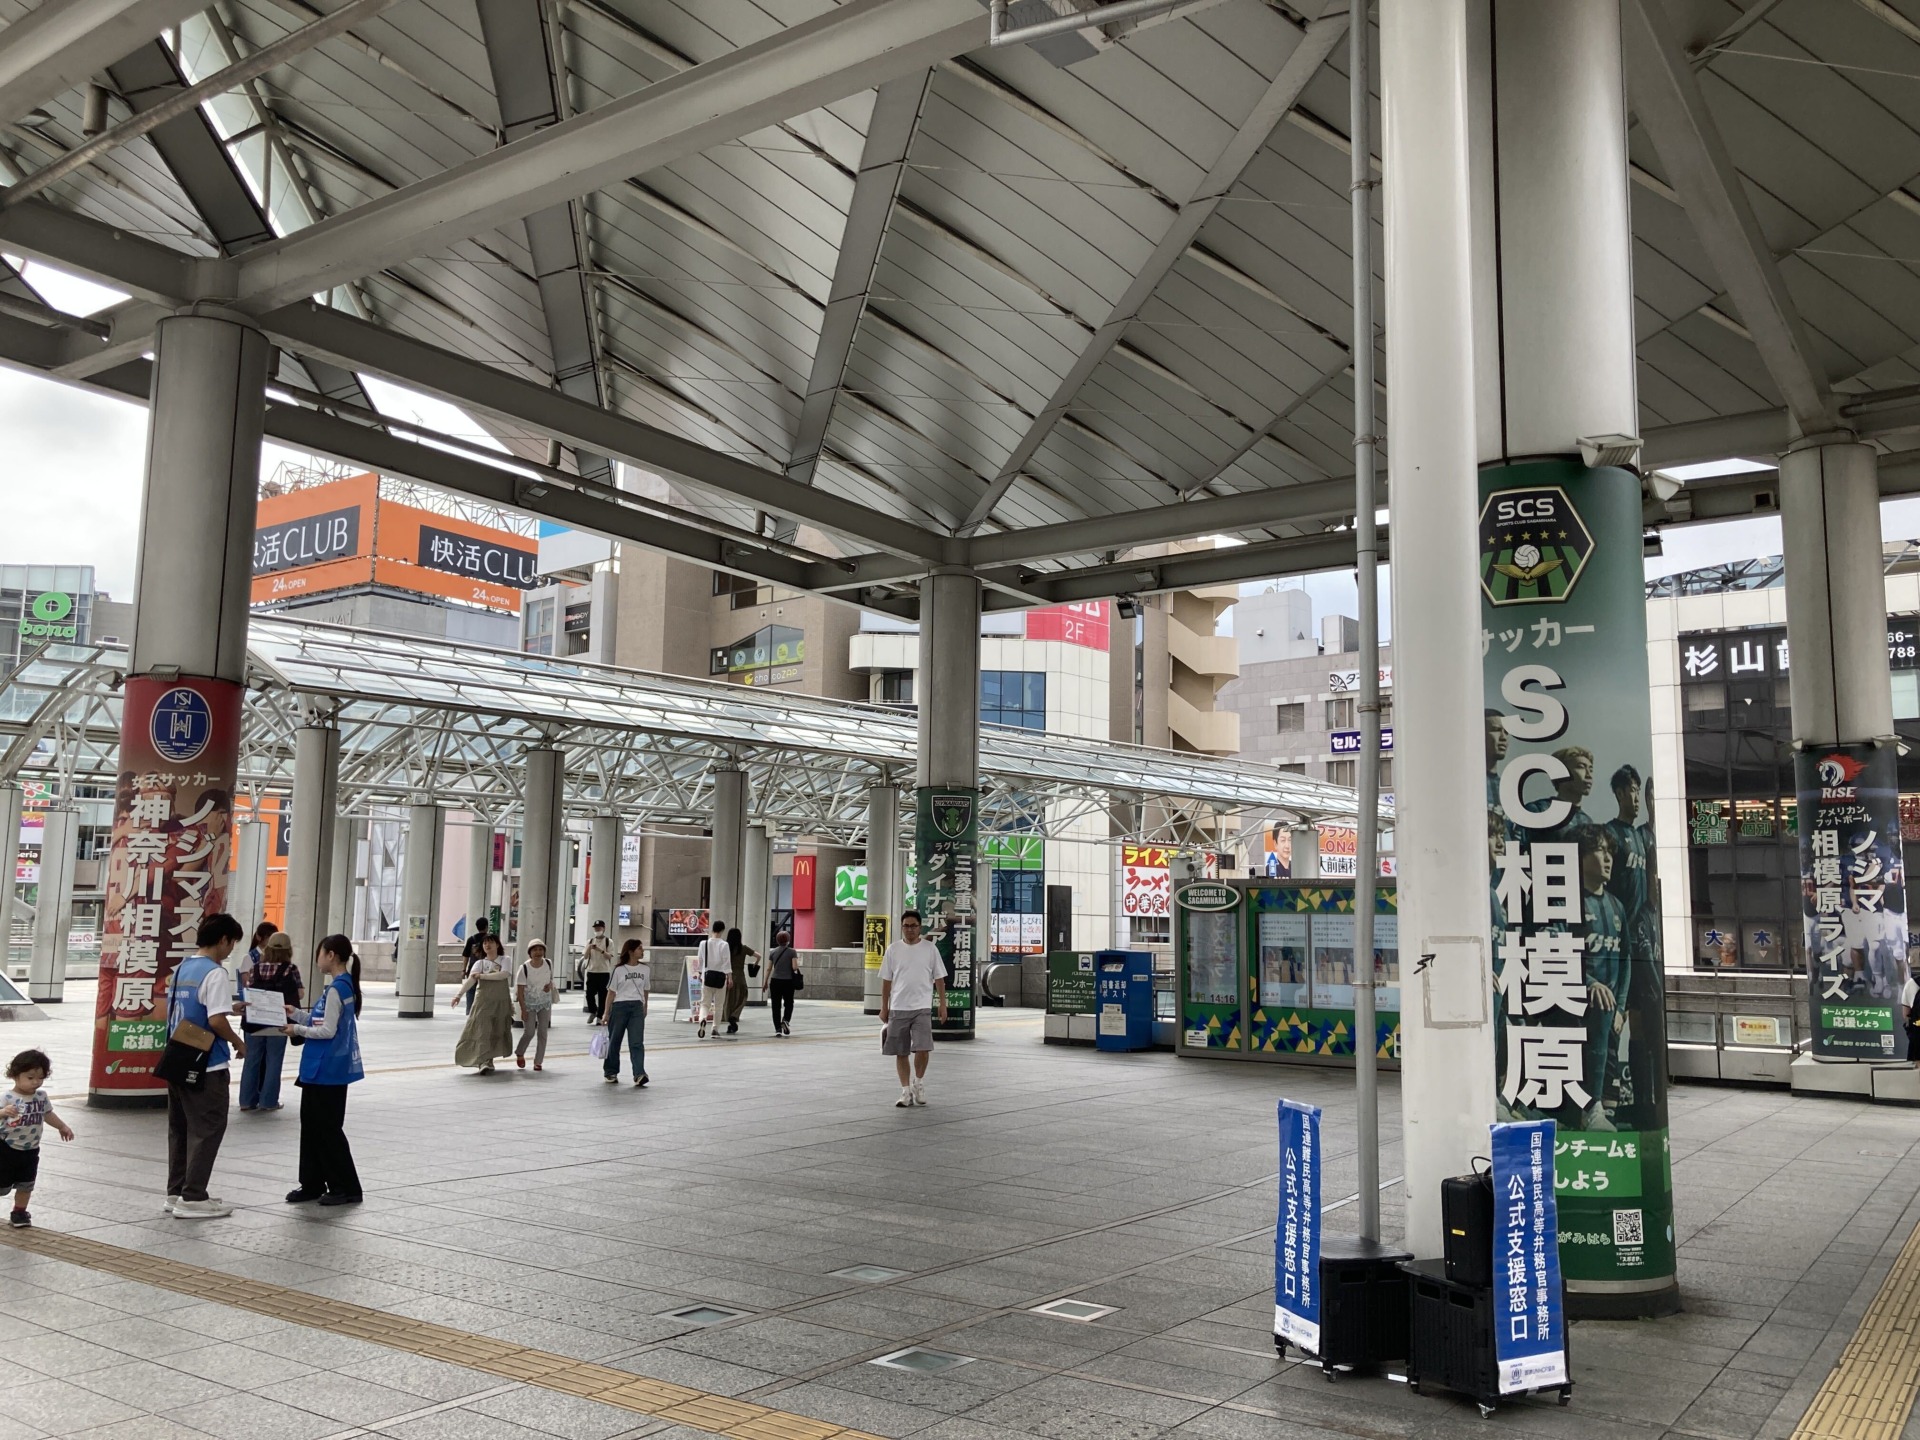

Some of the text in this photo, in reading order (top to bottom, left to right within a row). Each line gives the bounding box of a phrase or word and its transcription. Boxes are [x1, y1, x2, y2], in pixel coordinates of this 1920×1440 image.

[1497, 498, 1555, 520] SCS
[1496, 520, 1514, 528] SPORTS
[431, 535, 540, 585] 快活CLU
[288, 577, 307, 590] OPEN
[490, 595, 510, 606] OPEN
[18, 617, 76, 638] bono
[1065, 621, 1085, 641] 2F
[754, 668, 798, 684] chocoZAP
[131, 771, 221, 790] 女子サッカー
[1742, 809, 1771, 821] 1対2
[1818, 805, 1865, 818] アメリカン
[1816, 813, 1873, 828] フットボール
[1693, 828, 1728, 845] 保証
[1741, 822, 1772, 837] 個別
[935, 841, 968, 851] ラグビー
[1319, 840, 1356, 854] ON4
[1851, 829, 1884, 914] ノジマ
[1187, 888, 1228, 897] WELCOME TO
[1496, 664, 1592, 1110] SC相模原
[111, 794, 171, 1012] 神奈川相模原
[1187, 896, 1227, 905] SAGAMIHARA
[953, 854, 972, 988] 三菱重工相模原
[1811, 829, 1850, 1001] 相模原ライズ
[624, 971, 645, 981] ADIDAS
[1210, 994, 1235, 1004] 14:16
[1822, 1008, 1891, 1018] ホームタウンチームを
[1832, 1017, 1880, 1028] 応援しよう
[122, 1034, 168, 1050] 応援し
[1284, 1146, 1298, 1299] 公式支援窓口
[1530, 1131, 1550, 1341] 国連難民高等弁務官事務所
[1507, 1173, 1528, 1342] 公式支援窓口
